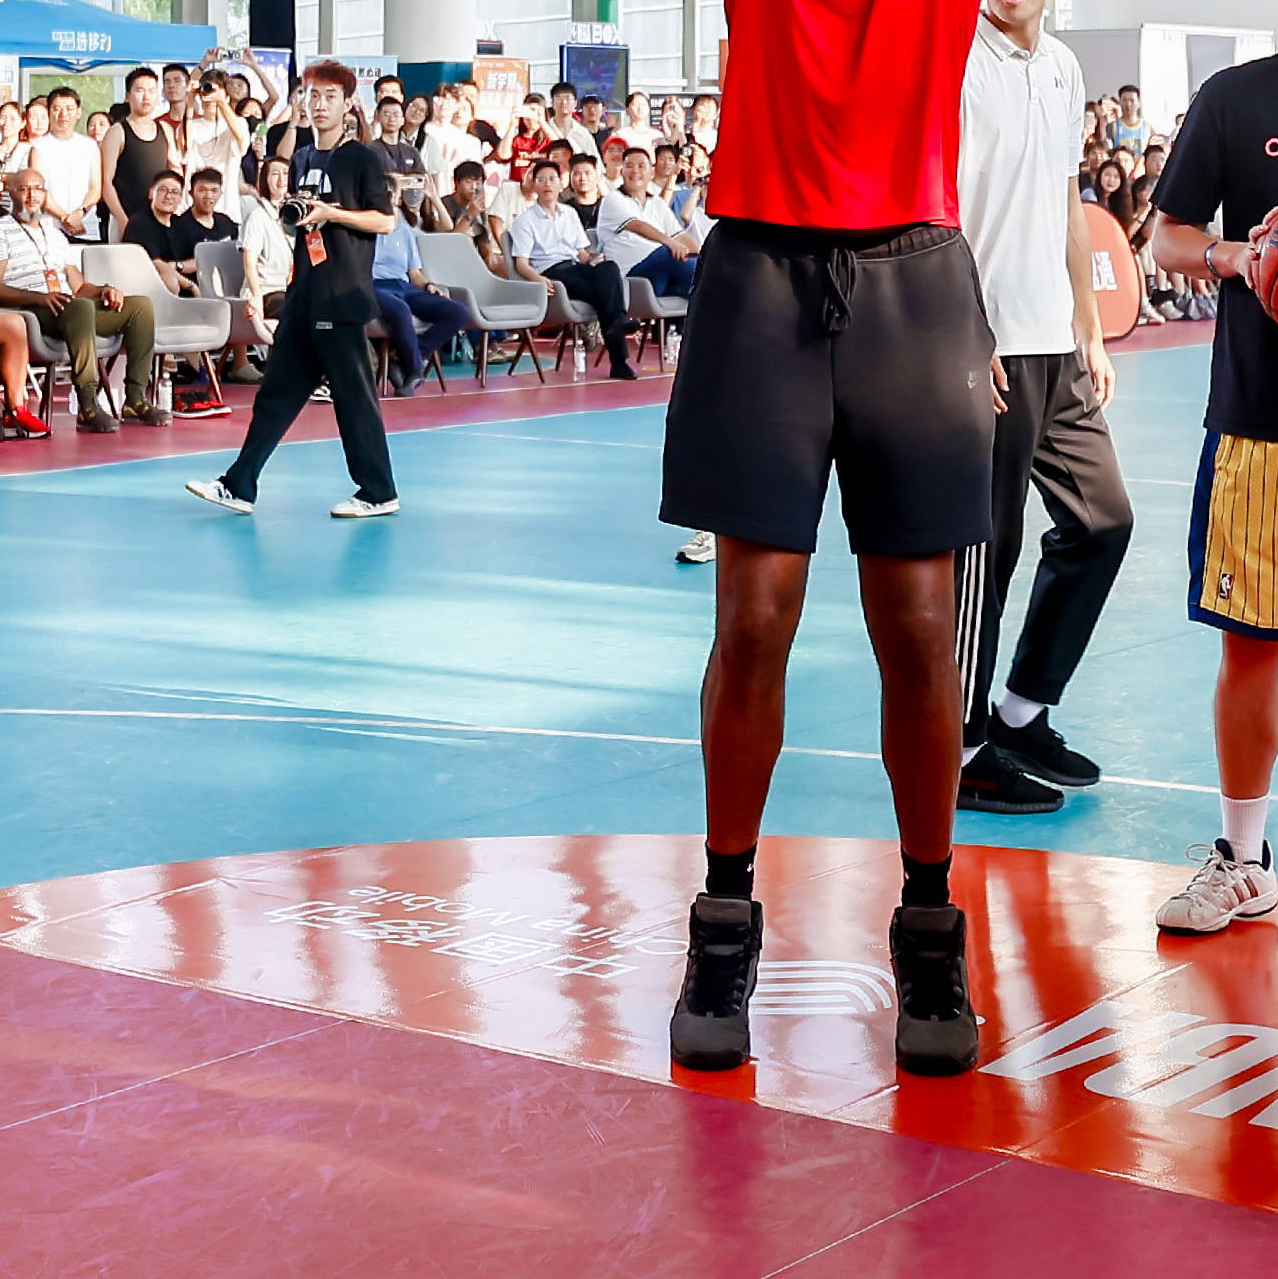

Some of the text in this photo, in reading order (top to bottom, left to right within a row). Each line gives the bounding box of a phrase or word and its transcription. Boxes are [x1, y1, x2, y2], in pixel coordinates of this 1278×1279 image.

[347, 885, 528, 926] Mobile
[263, 900, 640, 978] 中国移动
